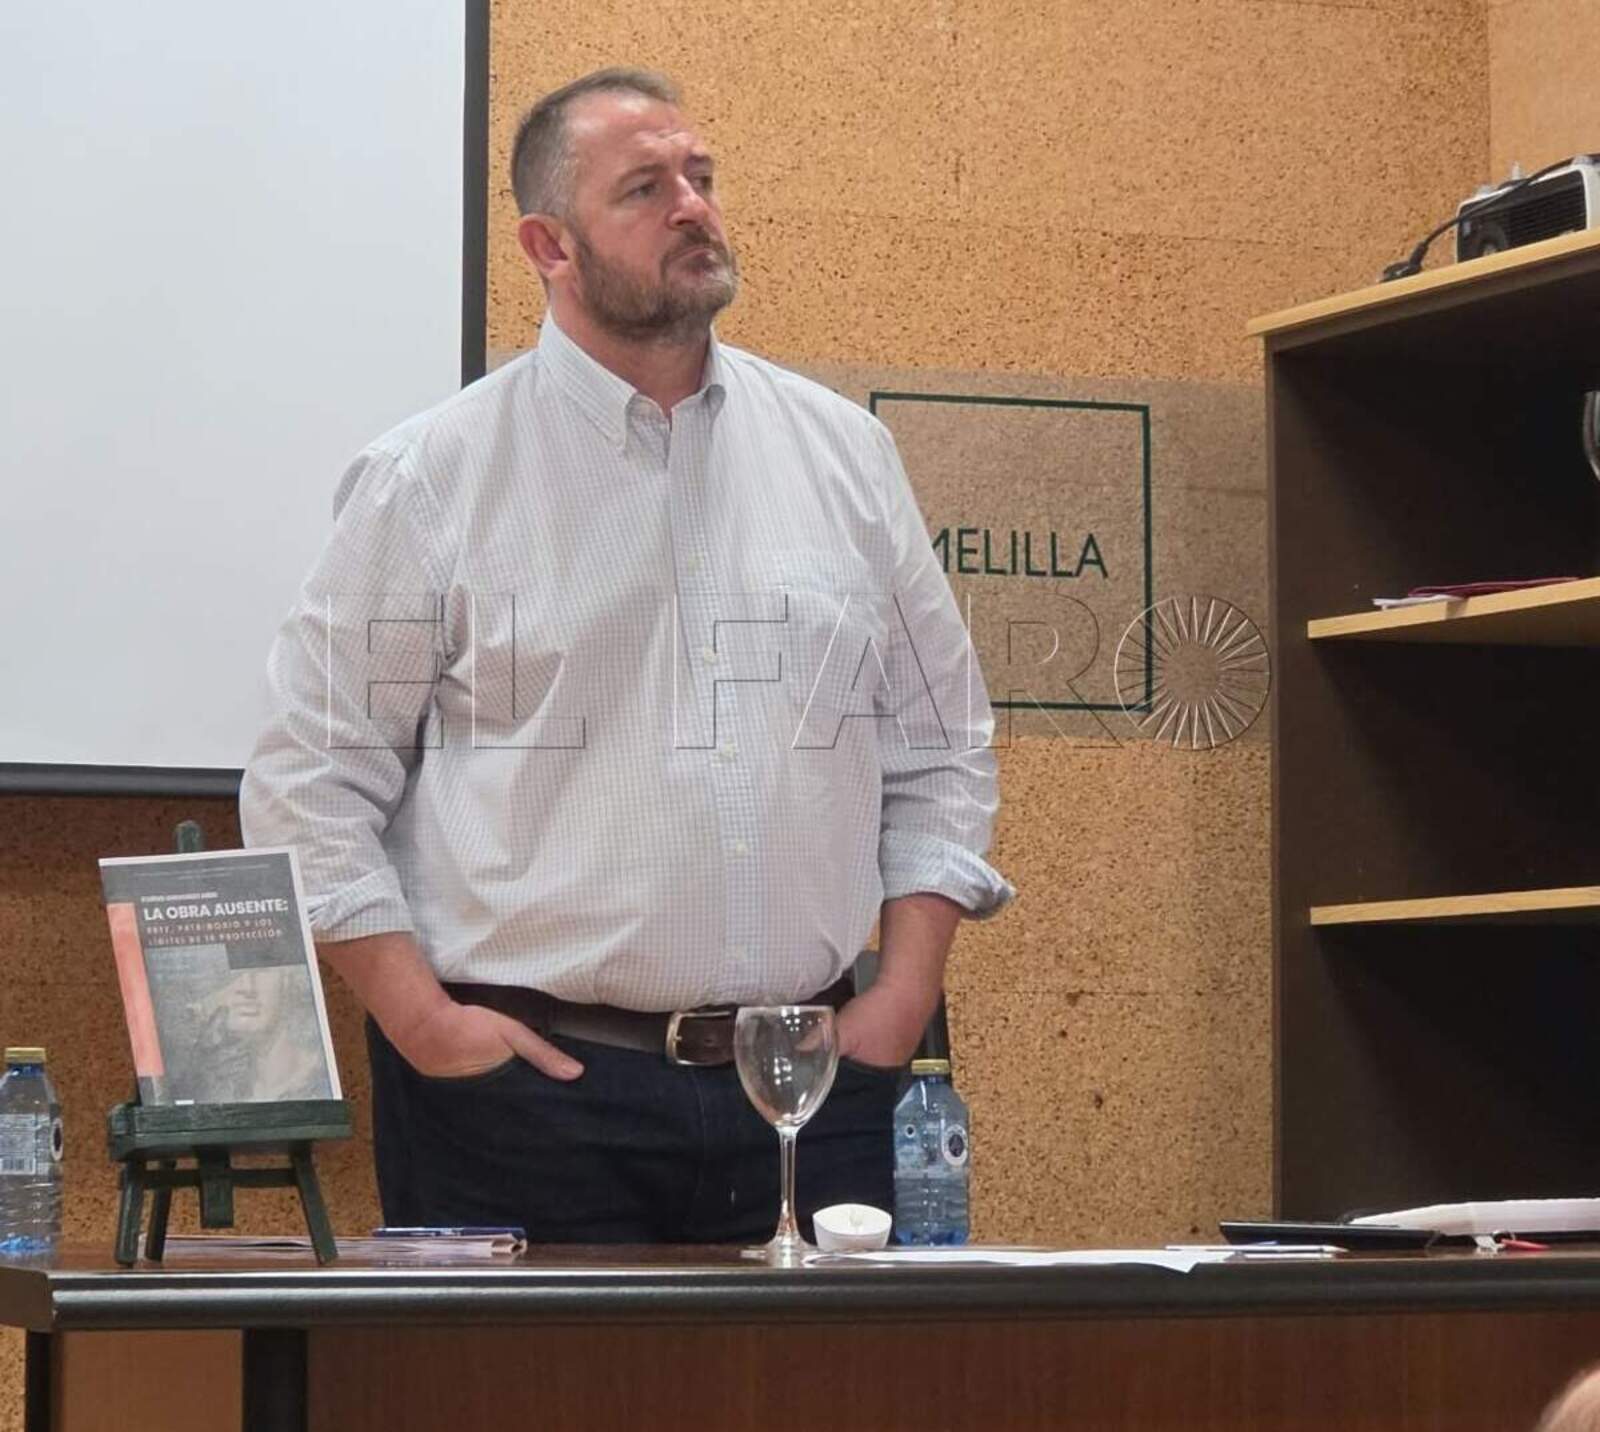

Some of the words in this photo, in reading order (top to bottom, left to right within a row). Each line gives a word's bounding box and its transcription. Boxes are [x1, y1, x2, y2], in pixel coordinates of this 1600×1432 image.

[143, 906, 163, 921] LA
[166, 904, 211, 920] OBRA
[214, 898, 289, 917] AUSENTE:
